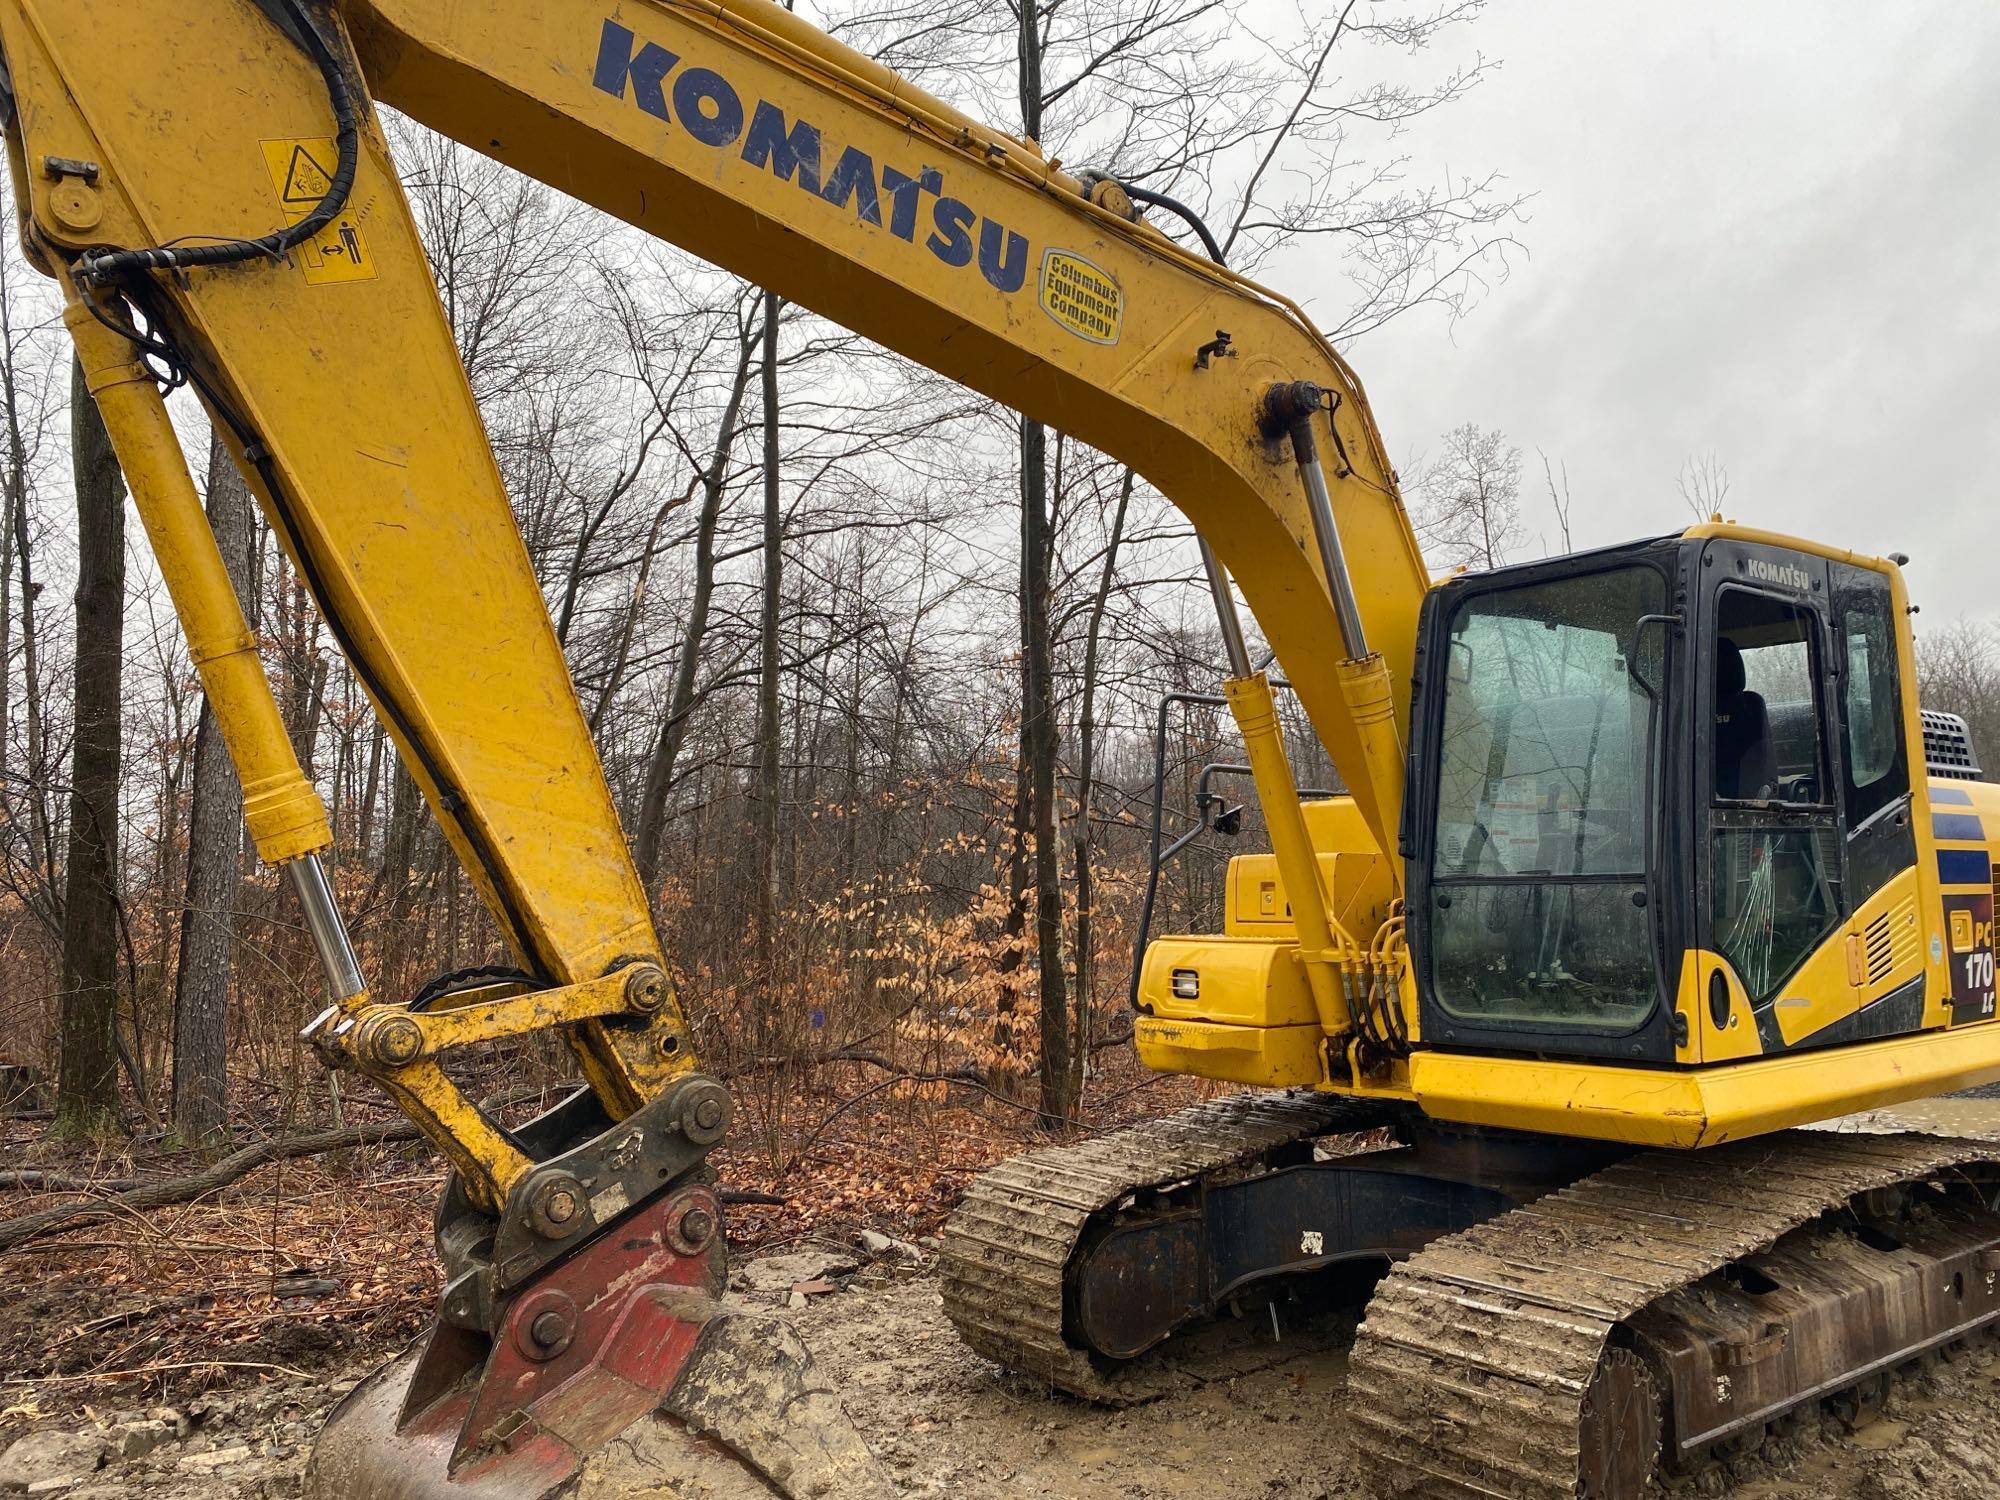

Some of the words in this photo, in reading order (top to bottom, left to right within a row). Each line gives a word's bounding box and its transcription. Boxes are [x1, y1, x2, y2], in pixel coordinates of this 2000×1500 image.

[592, 18, 1028, 293] KOMATSU
[1047, 272, 1119, 322] Equipment
[1051, 256, 1118, 304] Columbus
[1050, 293, 1112, 338] Company
[1747, 558, 1809, 590] KOMATSU
[1974, 921, 1992, 948] PC
[1965, 951, 1994, 989] 170
[1981, 991, 1995, 1014] LC
